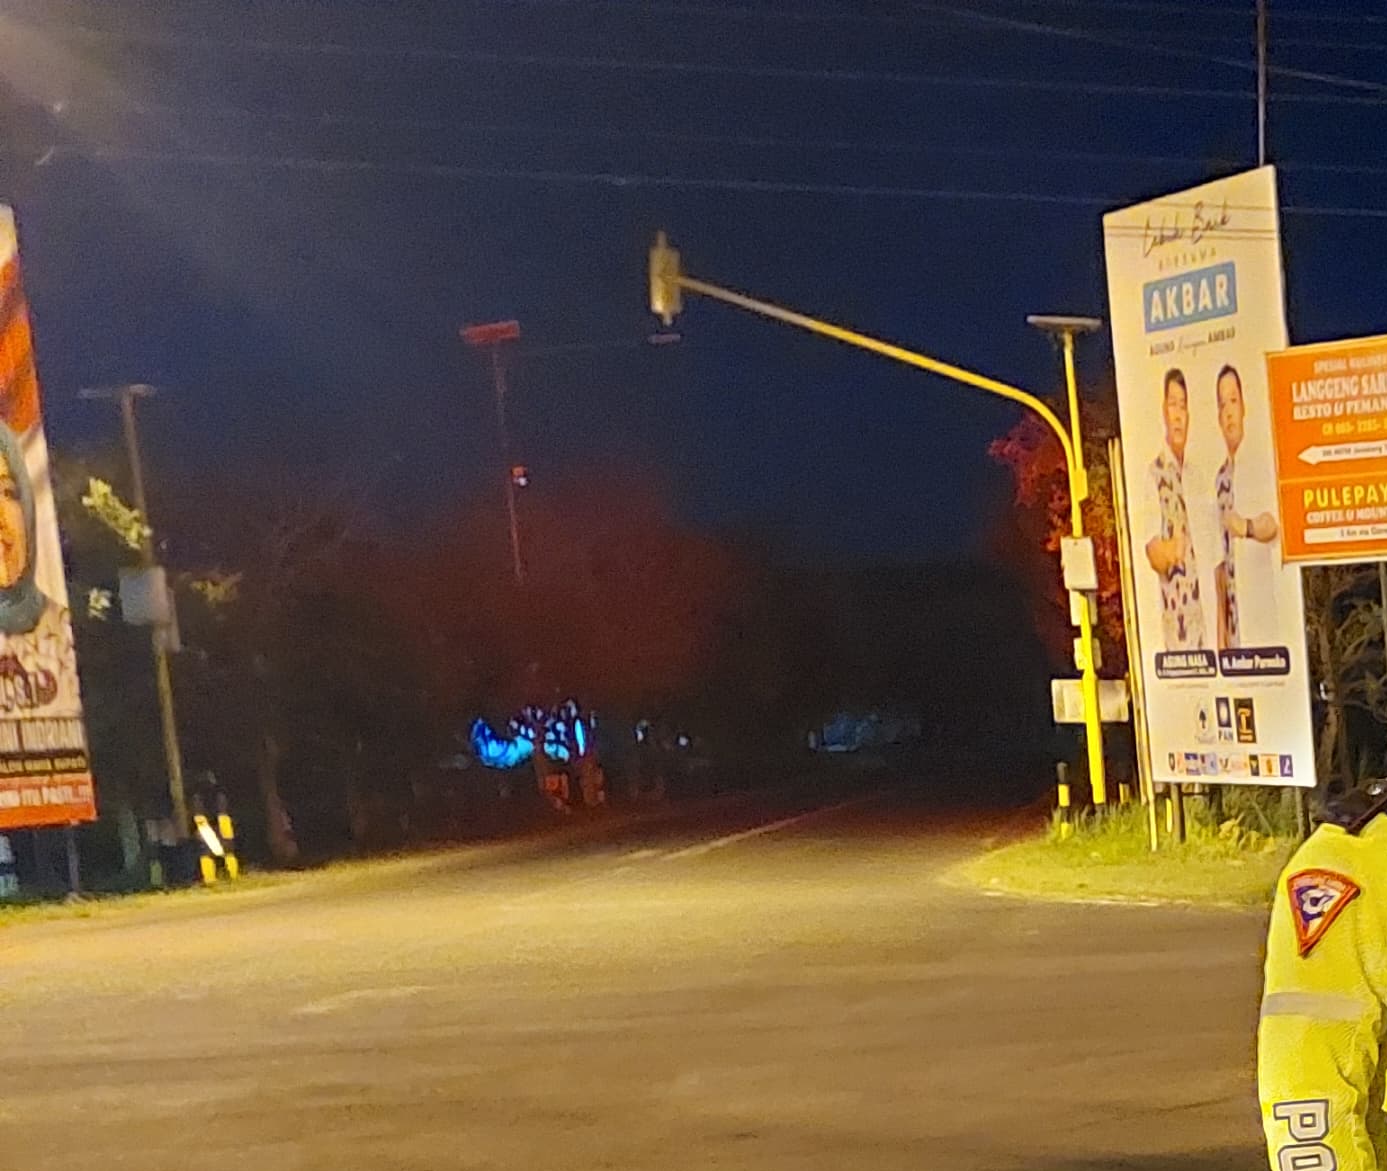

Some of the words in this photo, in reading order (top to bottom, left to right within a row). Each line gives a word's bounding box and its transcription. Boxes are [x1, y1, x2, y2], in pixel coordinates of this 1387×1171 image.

[1151, 273, 1230, 324] AKBAR
[1292, 375, 1360, 403] LANGGENG
[1293, 403, 1332, 421] RESTO
